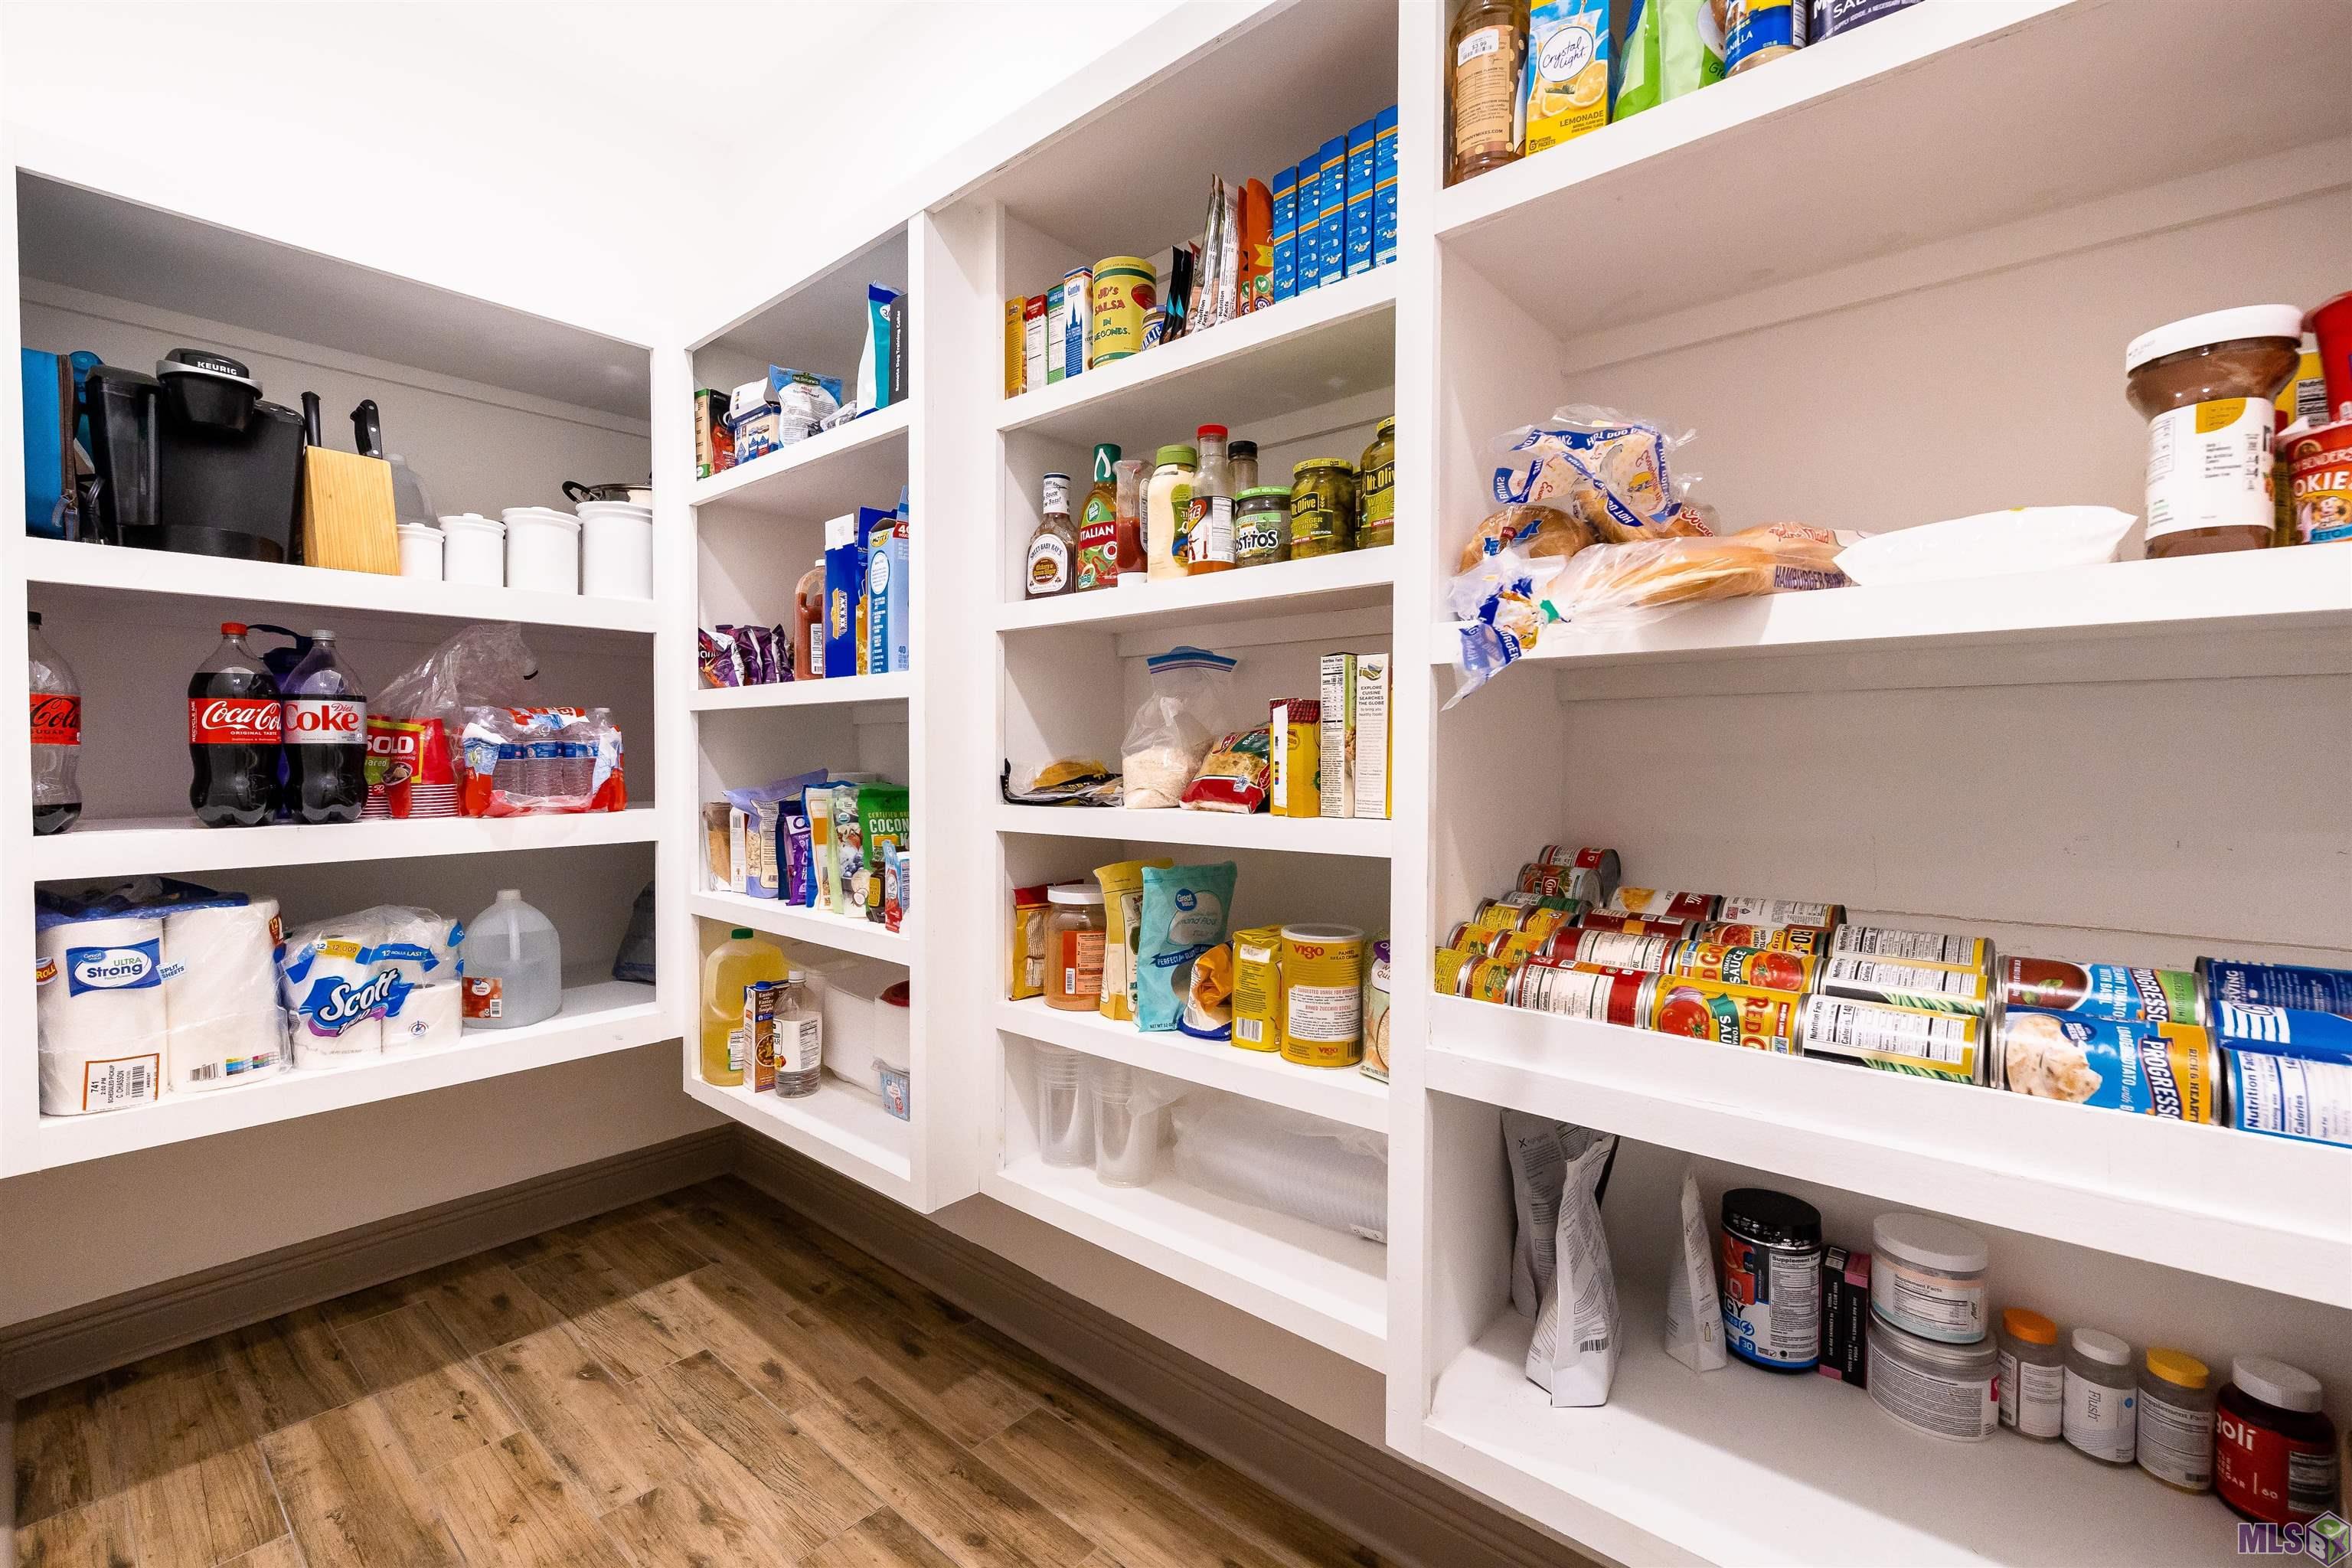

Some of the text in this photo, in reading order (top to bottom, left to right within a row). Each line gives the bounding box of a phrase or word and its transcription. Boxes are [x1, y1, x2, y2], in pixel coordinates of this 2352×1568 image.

[1543, 36, 1583, 68] Crystal
[1560, 110, 1604, 128] LEMONADE
[1538, 139, 1556, 148] PACKETS
[1098, 286, 1119, 299] JD'S
[1095, 299, 1126, 316] SALSA
[1197, 299, 1206, 325] Nutrition
[1103, 318, 1112, 327] IN
[198, 361, 237, 375] KEURIG
[1367, 467, 1394, 491] Mt. Oliv
[1048, 497, 1061, 505] Boss!
[1298, 498, 1316, 513] Olive
[1617, 510, 1635, 524] HOT
[1080, 524, 1114, 541] ITALIAN
[1030, 545, 1040, 560] SWEET
[1774, 565, 1824, 590] HAMBURGER
[201, 697, 281, 727] Coca-Col
[332, 703, 354, 712] Diet
[283, 704, 359, 731] Coke
[870, 818, 909, 833] COCON
[1177, 893, 1193, 903] Great
[1838, 932, 1847, 951] Nutrition
[1866, 935, 1875, 954] Calories
[113, 957, 142, 967] ULTRA
[160, 964, 180, 975] SPLIT
[1157, 956, 1179, 965] PERFECT
[1723, 954, 1733, 975] TOMATO
[1730, 950, 1747, 984] SAUCE
[87, 963, 143, 978] Strong
[161, 965, 185, 979] SHEETS
[2099, 969, 2111, 982] WITH
[320, 969, 398, 1021] Scott
[2112, 985, 2128, 1018] TOMATO
[2174, 993, 2185, 1017] SODIUM
[1745, 998, 1770, 1034] RED
[1810, 1001, 1822, 1040] Nutrition Facts
[1841, 1004, 1853, 1044] Calories 140
[1720, 1015, 1732, 1043] SAU
[2188, 1049, 2199, 1070] RICH
[90, 1081, 99, 1093] 741
[2142, 1040, 2180, 1119] PROGRESSO
[2246, 1075, 2259, 1128] Nutrition
[2294, 1095, 2305, 1135] Calories
[1895, 1274, 1926, 1289] Supplement
[1741, 1340, 1753, 1349] 30
[2088, 1390, 2101, 1419] Flush
